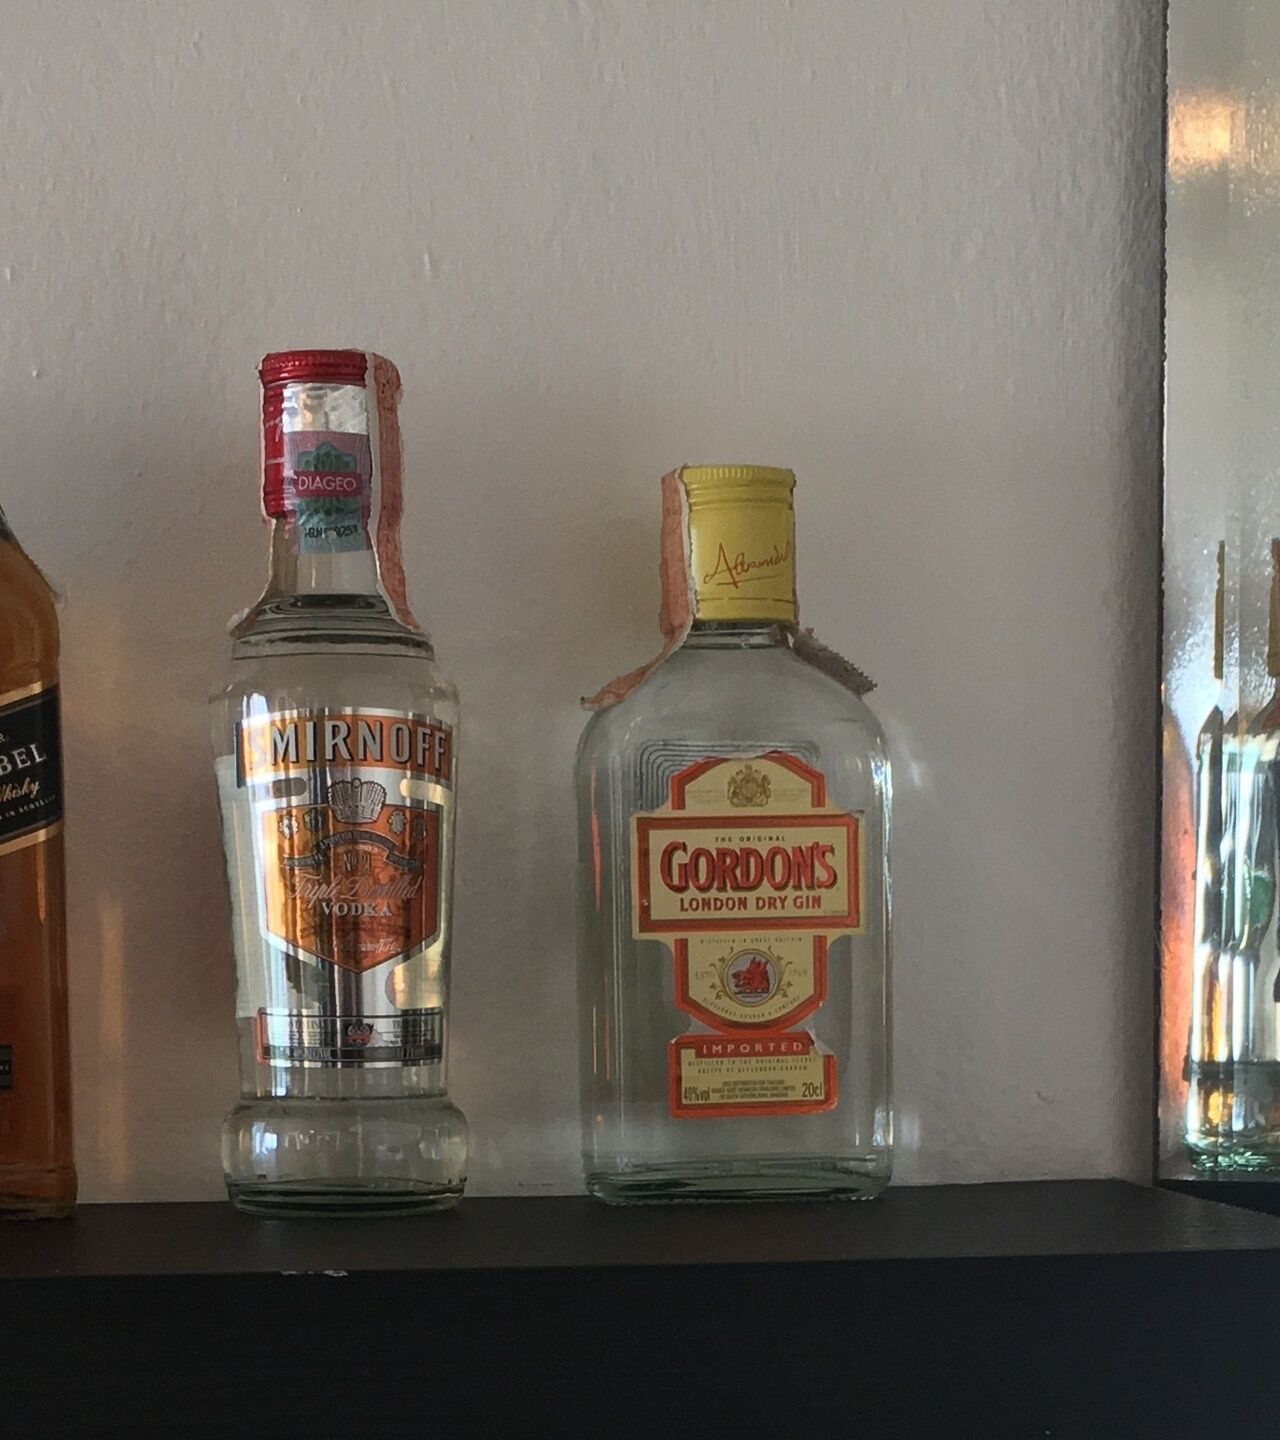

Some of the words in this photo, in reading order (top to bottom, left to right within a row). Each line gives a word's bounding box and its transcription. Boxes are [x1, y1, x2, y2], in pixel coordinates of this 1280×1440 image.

[298, 476, 357, 492] DIAGEO
[247, 720, 447, 772] SMIRNOFF
[715, 835, 733, 843] THE
[738, 834, 787, 843] ORIGINAL
[660, 839, 839, 894] GORDON'S
[285, 873, 340, 911] Triple
[340, 872, 423, 902] Distilled
[322, 901, 392, 918] VODKA
[679, 896, 748, 913] LONDON
[755, 895, 788, 911] DRY
[793, 894, 822, 911] GIN
[703, 1041, 804, 1055] IMPORTED
